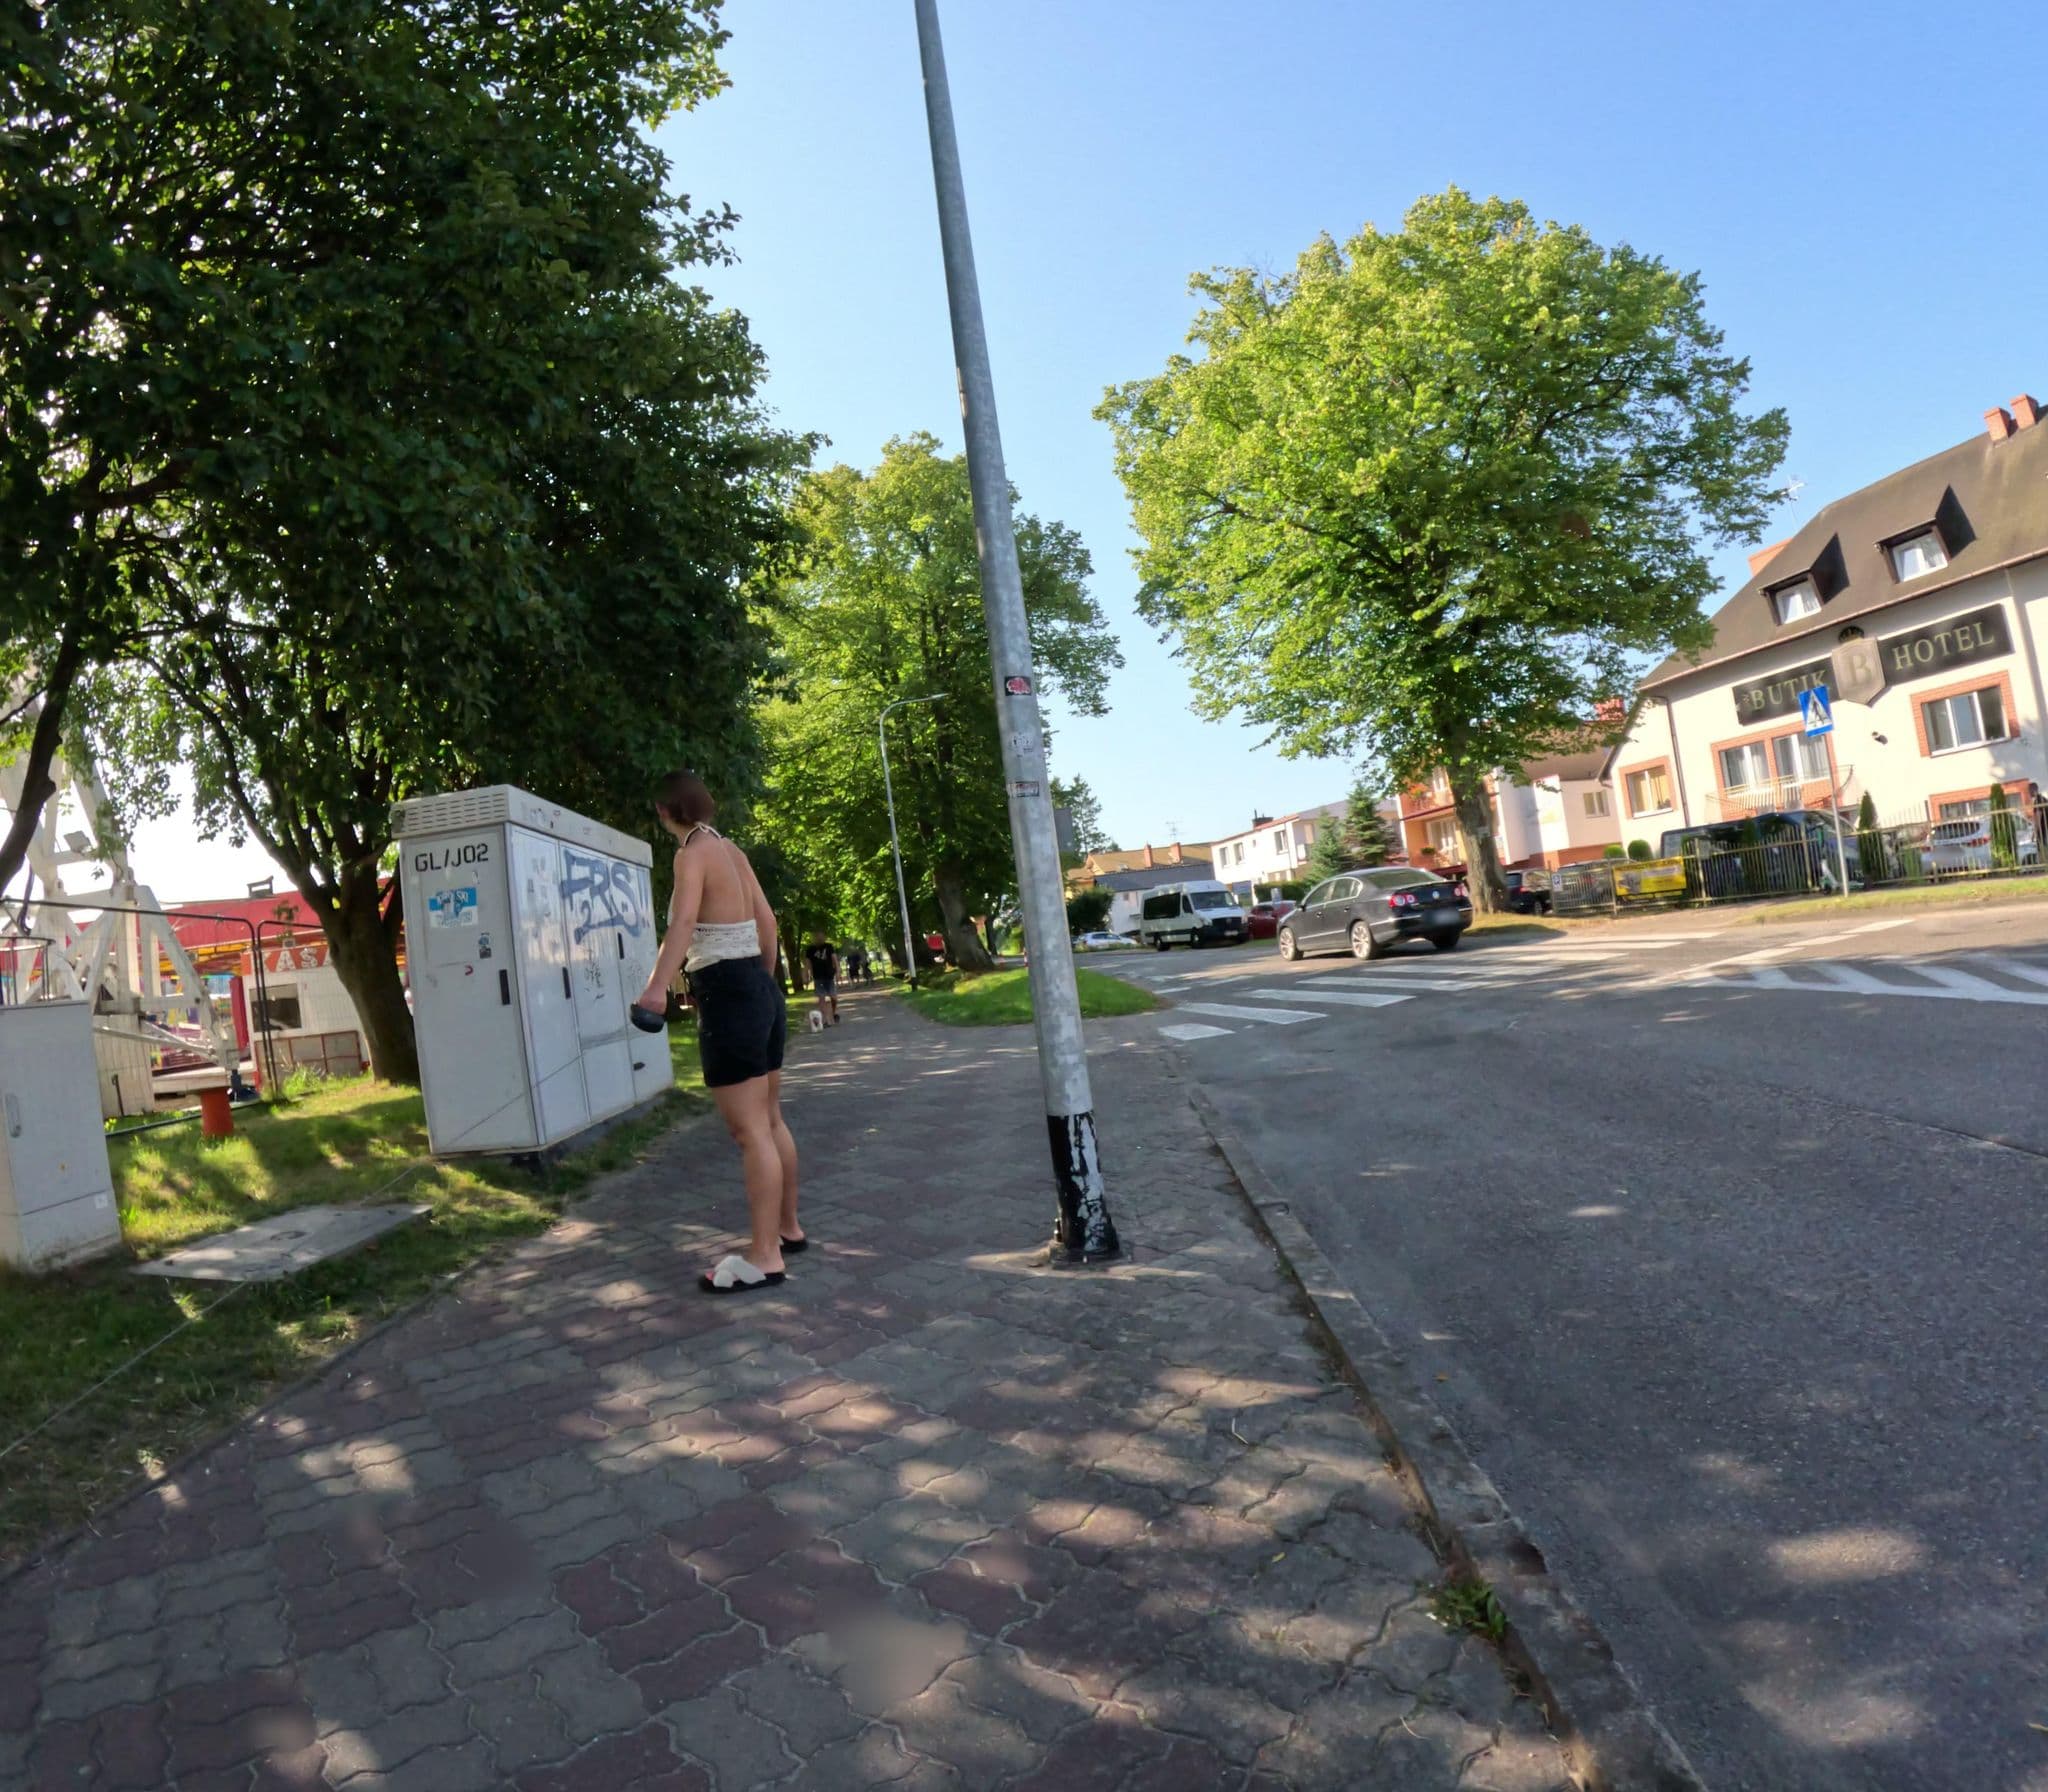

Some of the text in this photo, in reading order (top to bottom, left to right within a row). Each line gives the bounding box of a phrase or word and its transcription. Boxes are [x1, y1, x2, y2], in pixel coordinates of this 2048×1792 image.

[1749, 622, 1994, 710] BUTIK B HOTEL
